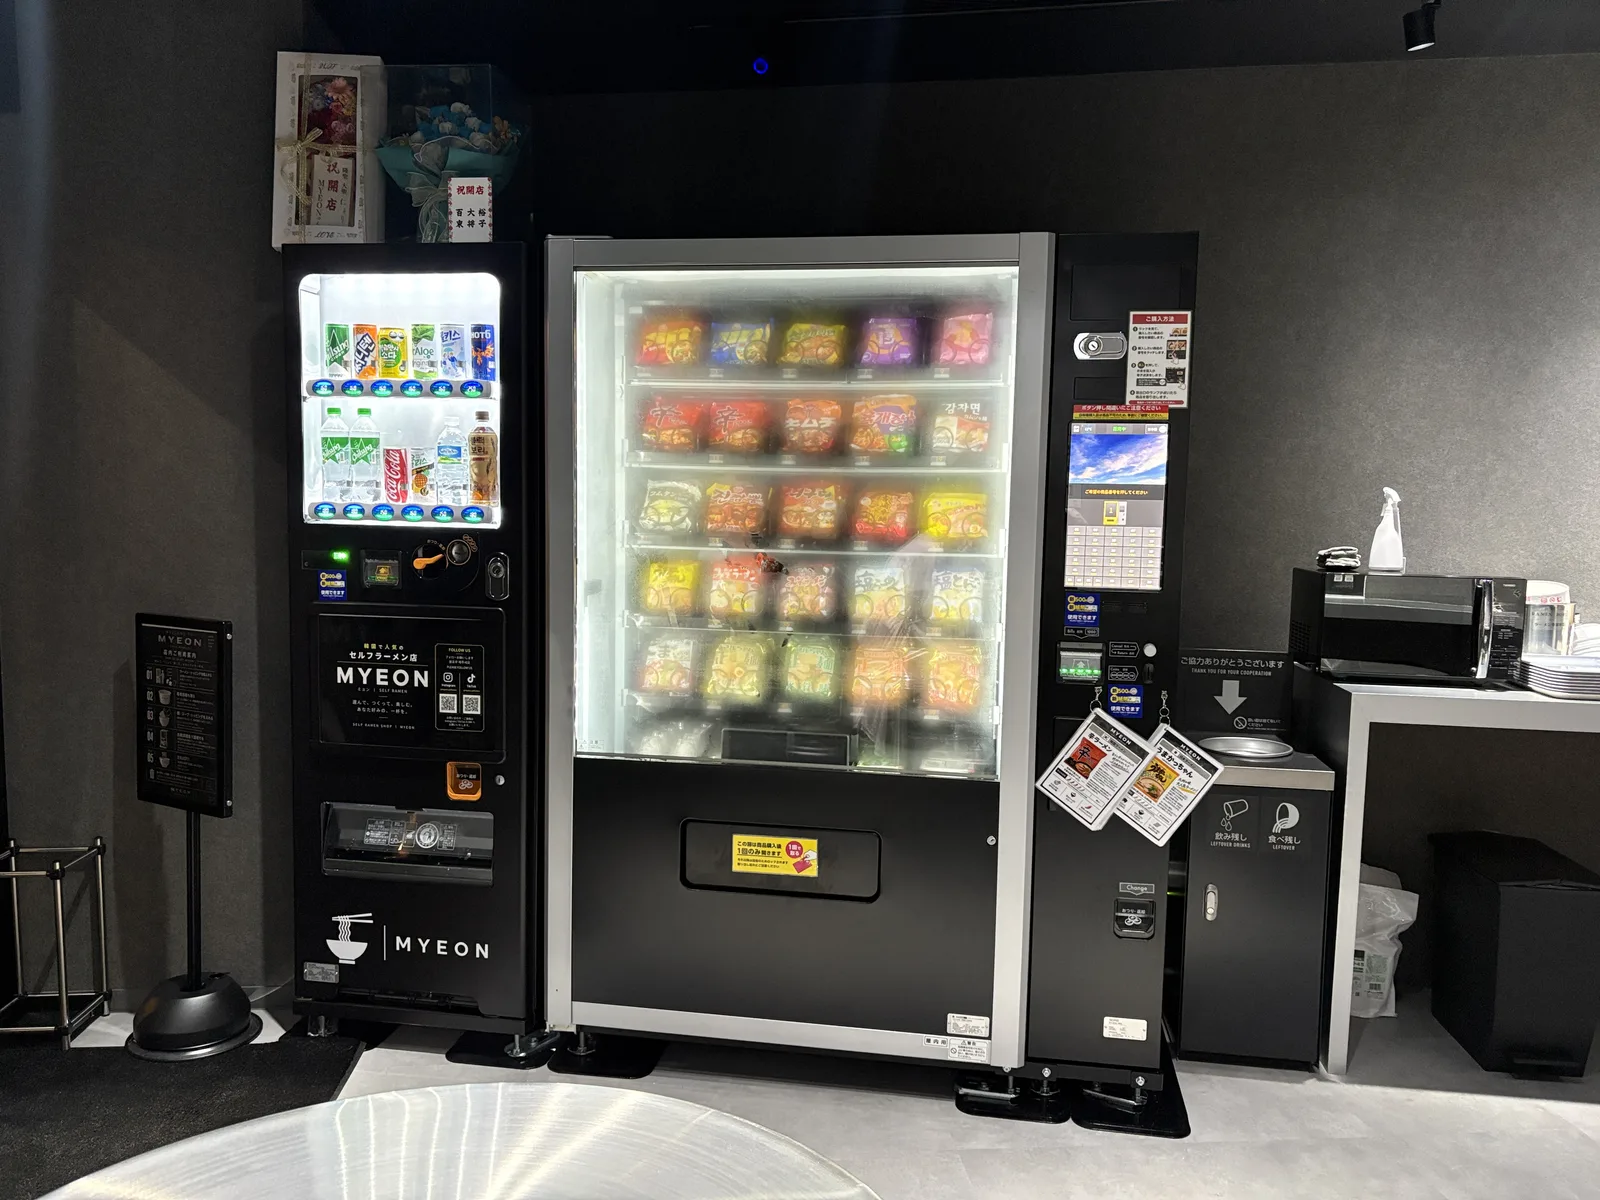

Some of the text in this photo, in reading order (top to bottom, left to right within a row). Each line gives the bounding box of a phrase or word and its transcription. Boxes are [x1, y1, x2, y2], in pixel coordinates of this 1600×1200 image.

[456, 185, 484, 195] 祝開店
[945, 403, 981, 415] 감자면
[714, 405, 745, 435] 辛
[158, 634, 202, 647] MYEON
[349, 651, 418, 662] セルフラーメン店
[1180, 656, 1285, 669] ご協力ありがとうございます
[336, 666, 429, 688] MYEON
[1087, 732, 1113, 752] 辛ラーメン
[1109, 727, 1132, 745] MYEON
[1078, 745, 1091, 760] 辛
[1180, 743, 1202, 761] MYEON
[1157, 746, 1193, 778] うまかっちゃん
[1215, 832, 1247, 842] 飲み残し
[1268, 834, 1301, 844] 食べ残し
[737, 848, 781, 856] 1回のみ開きます
[1126, 884, 1148, 892] Change
[395, 935, 489, 960] MYEON
